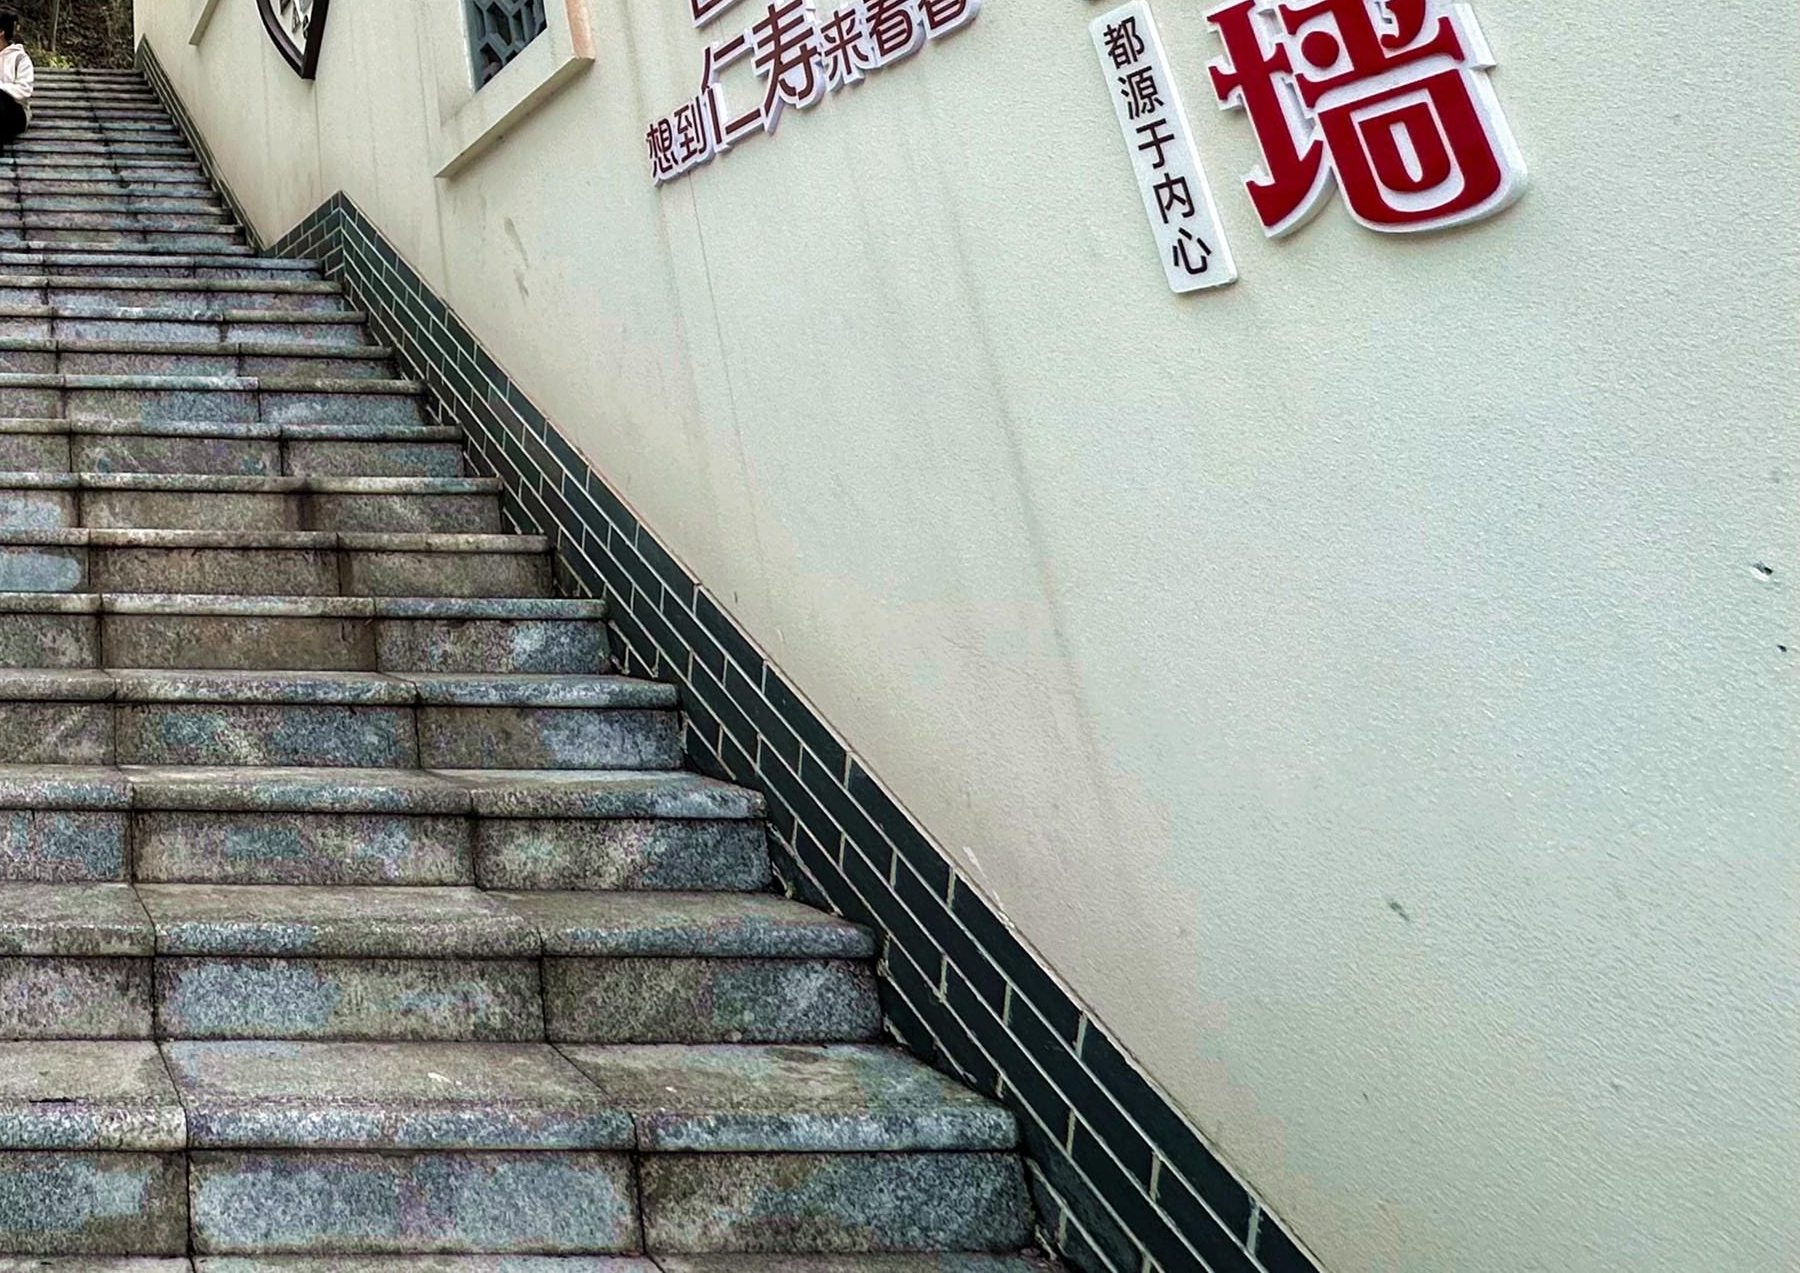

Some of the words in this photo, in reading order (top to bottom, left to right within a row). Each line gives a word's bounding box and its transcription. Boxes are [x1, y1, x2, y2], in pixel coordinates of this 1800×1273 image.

[1103, 16, 1212, 275] 都源于内心
